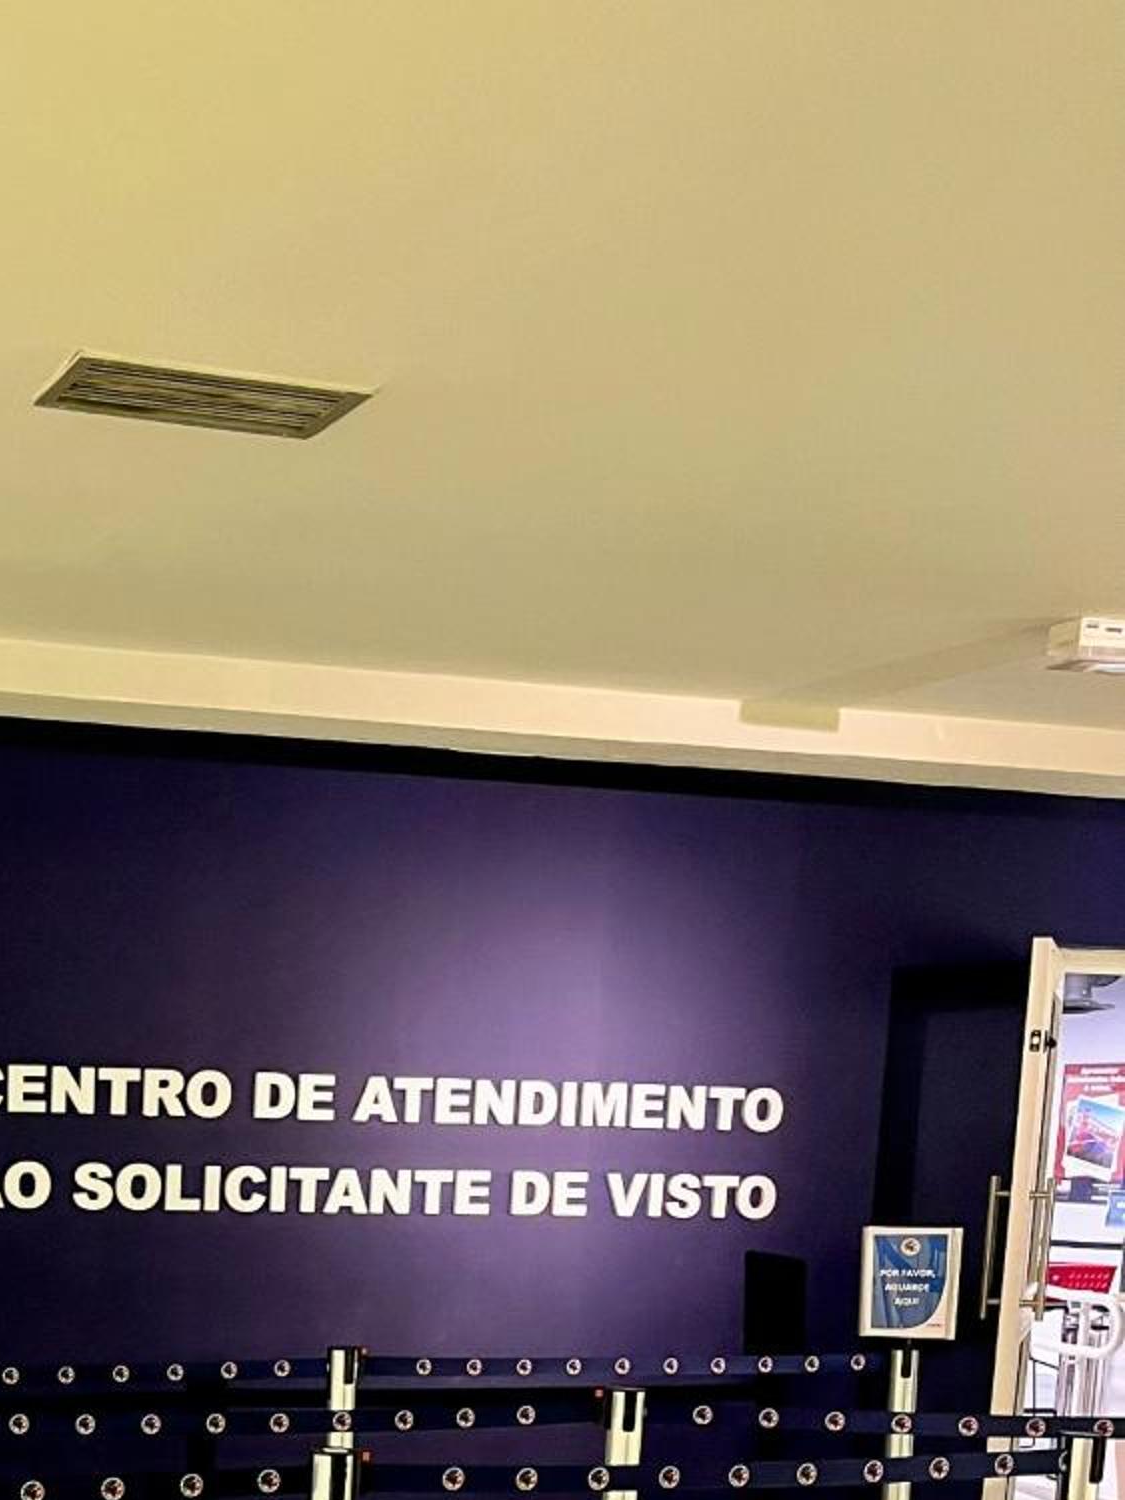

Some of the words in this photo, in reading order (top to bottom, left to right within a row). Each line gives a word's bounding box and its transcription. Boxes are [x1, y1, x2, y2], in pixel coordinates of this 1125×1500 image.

[253, 1071, 337, 1122] DE
[351, 1075, 785, 1134] ATENDIMENTO
[72, 1161, 493, 1217] SOLICITANTE
[509, 1169, 591, 1218] DE
[606, 1172, 777, 1220] VISTO
